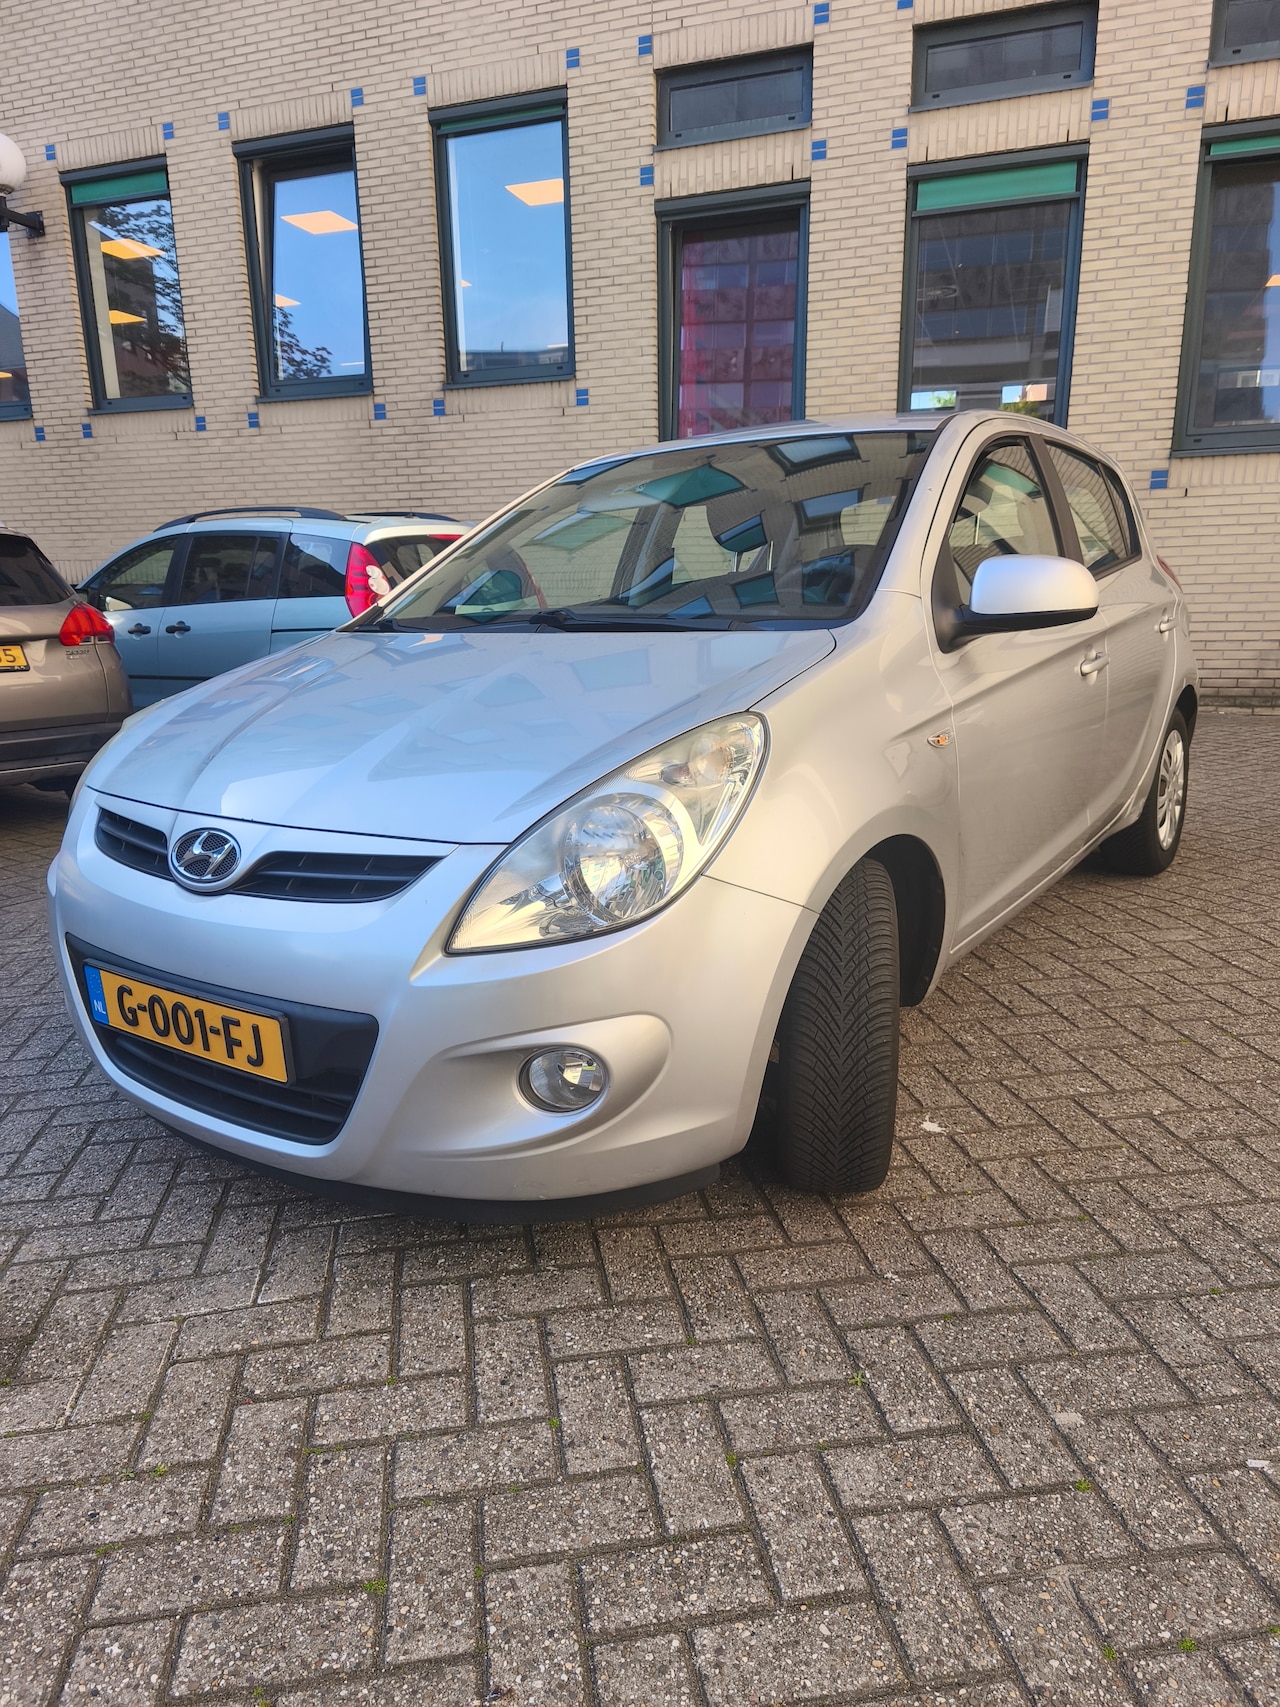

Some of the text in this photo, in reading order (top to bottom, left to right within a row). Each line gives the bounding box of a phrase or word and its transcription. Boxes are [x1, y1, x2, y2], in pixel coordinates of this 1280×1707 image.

[0, 648, 17, 663] 5
[93, 999, 107, 1015] NL
[116, 984, 264, 1068] G-001-FJ
